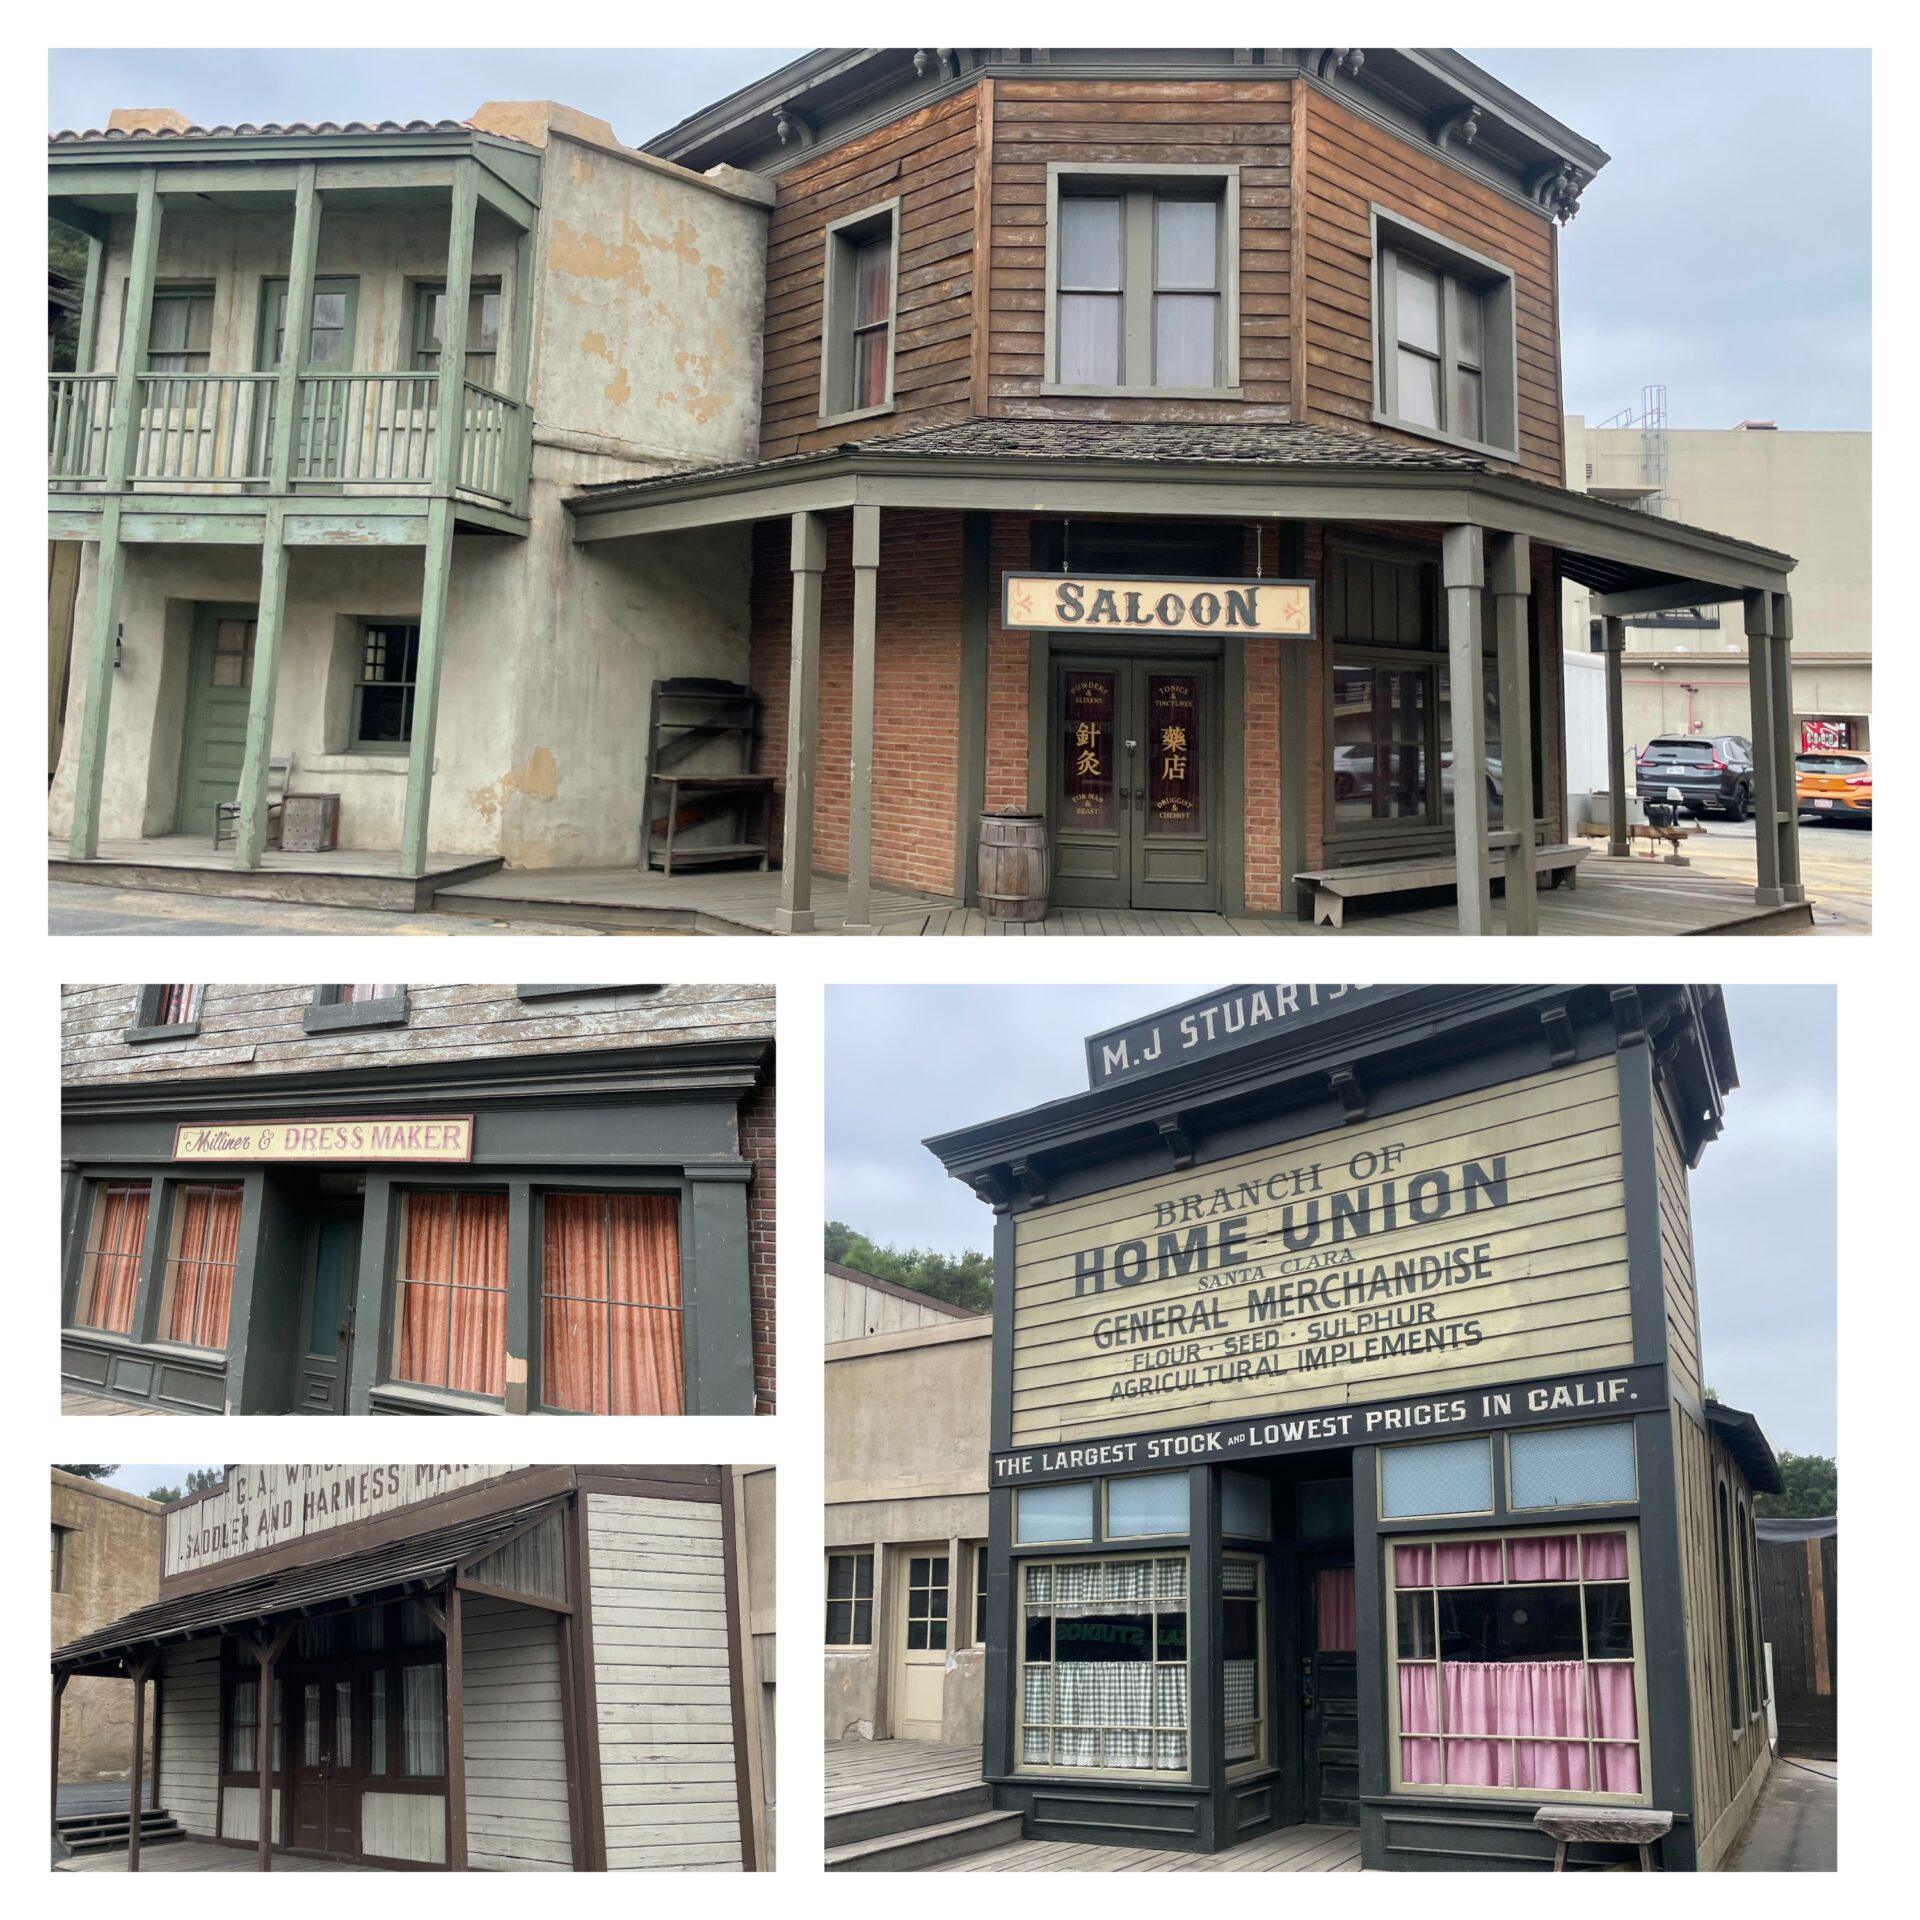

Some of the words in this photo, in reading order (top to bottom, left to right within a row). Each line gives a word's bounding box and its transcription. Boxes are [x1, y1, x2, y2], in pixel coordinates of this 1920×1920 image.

[1055, 582, 1262, 627] SALOON
[1158, 684, 1189, 695] TONICS
[1076, 722, 1102, 776] 針灸
[1161, 726, 1188, 780] 藥店
[1072, 793, 1087, 803] FOR
[1156, 797, 1194, 809] DRUGGIST
[1171, 804, 1178, 812] &
[183, 1129, 251, 1153] Milliner
[258, 1128, 275, 1150] &
[284, 1126, 366, 1152] DRESS
[370, 1124, 463, 1151] MAKER
[1153, 1163, 1322, 1229] BRANCH
[1349, 1142, 1406, 1181] OF
[1074, 1216, 1249, 1297] HOME
[1281, 1156, 1510, 1252] UNION
[1093, 1297, 1229, 1350] GENERAL
[1248, 1243, 1493, 1323] MERCHANDISE
[1198, 1266, 1266, 1291] SANTA
[1280, 1248, 1357, 1275] CLARA
[1110, 1354, 1288, 1401] AGRICULTURAL
[1298, 1320, 1483, 1373] IMPLEMENTS
[1133, 1342, 1202, 1372] FLOUR
[1223, 1329, 1280, 1357] SEED
[1307, 1301, 1437, 1342] SULPHUR
[995, 1455, 1032, 1477] THE
[1042, 1443, 1138, 1472] LARGEST
[1147, 1431, 1224, 1458] STOCK
[1228, 1433, 1246, 1446] AND
[1249, 1415, 1353, 1447] LOWEST
[1366, 1400, 1466, 1432] PRICES
[1482, 1393, 1512, 1418] IN
[1527, 1378, 1639, 1412] CALIF.
[186, 1513, 249, 1559] SADDLER
[257, 1499, 293, 1537] AND
[302, 1465, 400, 1522] HARNESS
